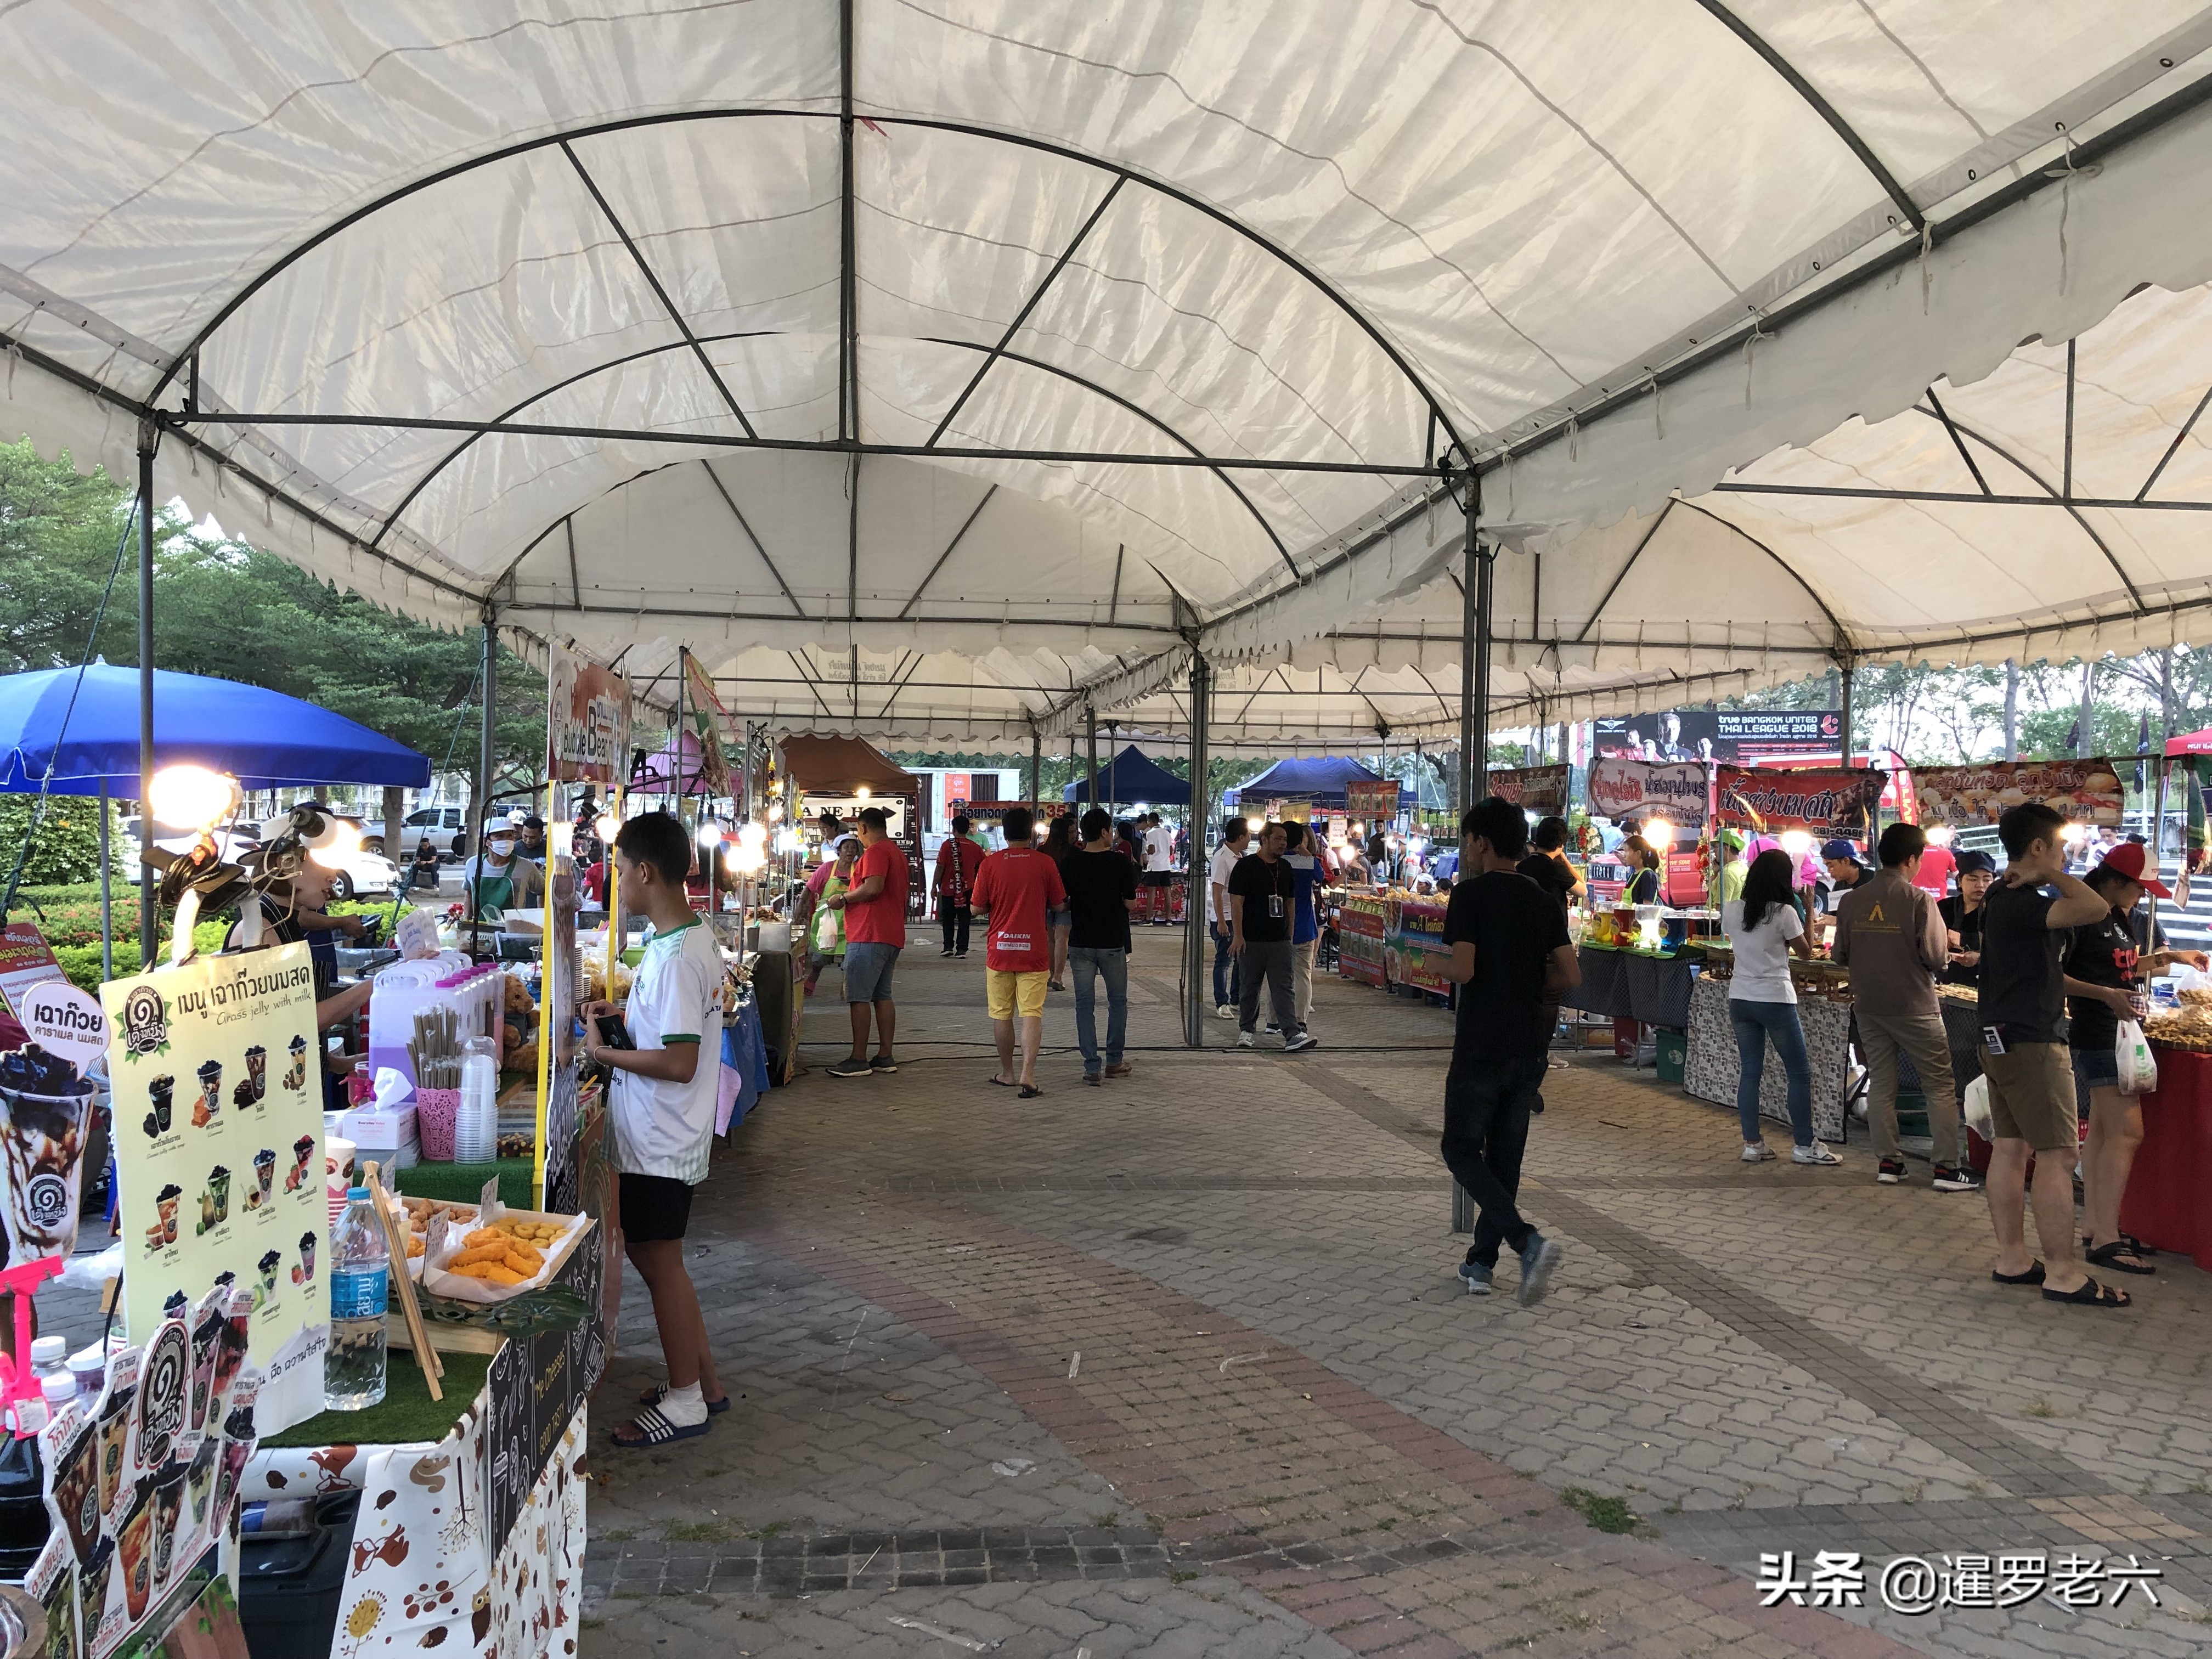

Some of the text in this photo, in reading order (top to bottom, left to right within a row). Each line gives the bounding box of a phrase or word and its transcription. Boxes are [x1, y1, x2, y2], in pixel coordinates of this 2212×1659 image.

[564, 723, 586, 755] Bubble
[1718, 724, 1817, 733] THAI LEAGUE 2018
[803, 806, 864, 817] A NE H
[1046, 804, 1066, 819] 35
[950, 838, 960, 871] BANGKO
[2113, 948, 2137, 968] tru
[178, 967, 310, 1019] เมนู เฉาก๊วยนมสด
[35, 1002, 103, 1032] เฉาก๊วย
[216, 988, 312, 1025] Grass jelly with milk
[35, 1026, 103, 1046] คาราเมล นมสด
[258, 1375, 266, 1385] น
[540, 1399, 565, 1455] GOOD TASTY
